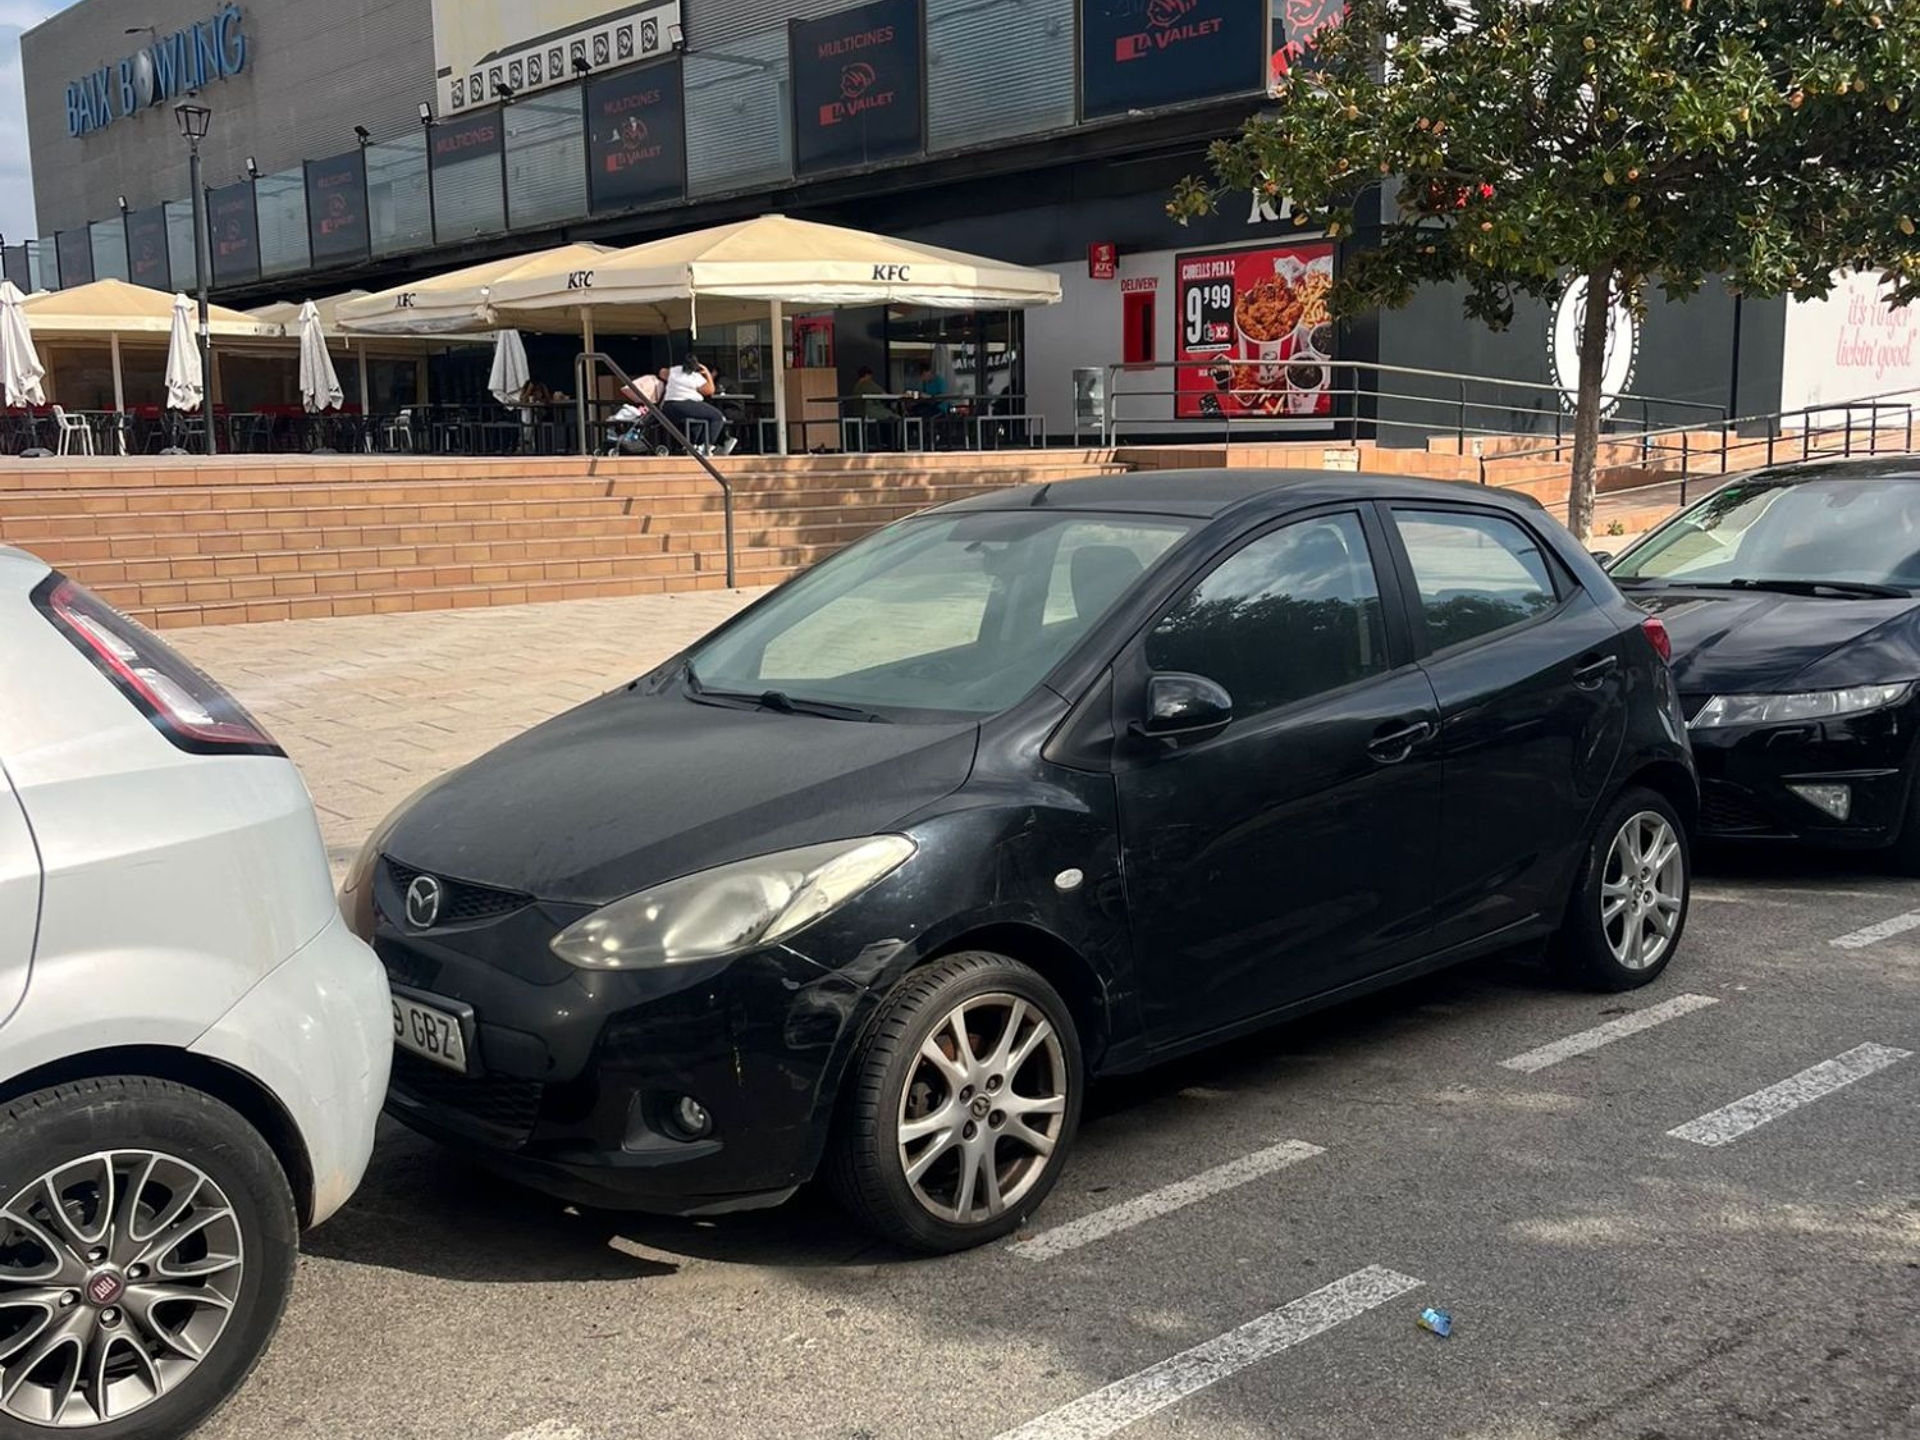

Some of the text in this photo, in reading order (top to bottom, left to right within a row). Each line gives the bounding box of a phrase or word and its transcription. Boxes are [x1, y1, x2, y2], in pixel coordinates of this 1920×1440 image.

[819, 26, 894, 56] MULTICINES
[1155, 18, 1222, 49] VAILET
[66, 6, 246, 137] BAIX BOWLING
[847, 91, 894, 116] VAILET
[567, 270, 594, 289] KFC
[872, 264, 910, 282] KFC
[1230, 259, 1236, 276] 2
[1120, 276, 1158, 292] DELIVERY
[410, 1008, 456, 1062] GBZ
[93, 1275, 118, 1300] FIAT
